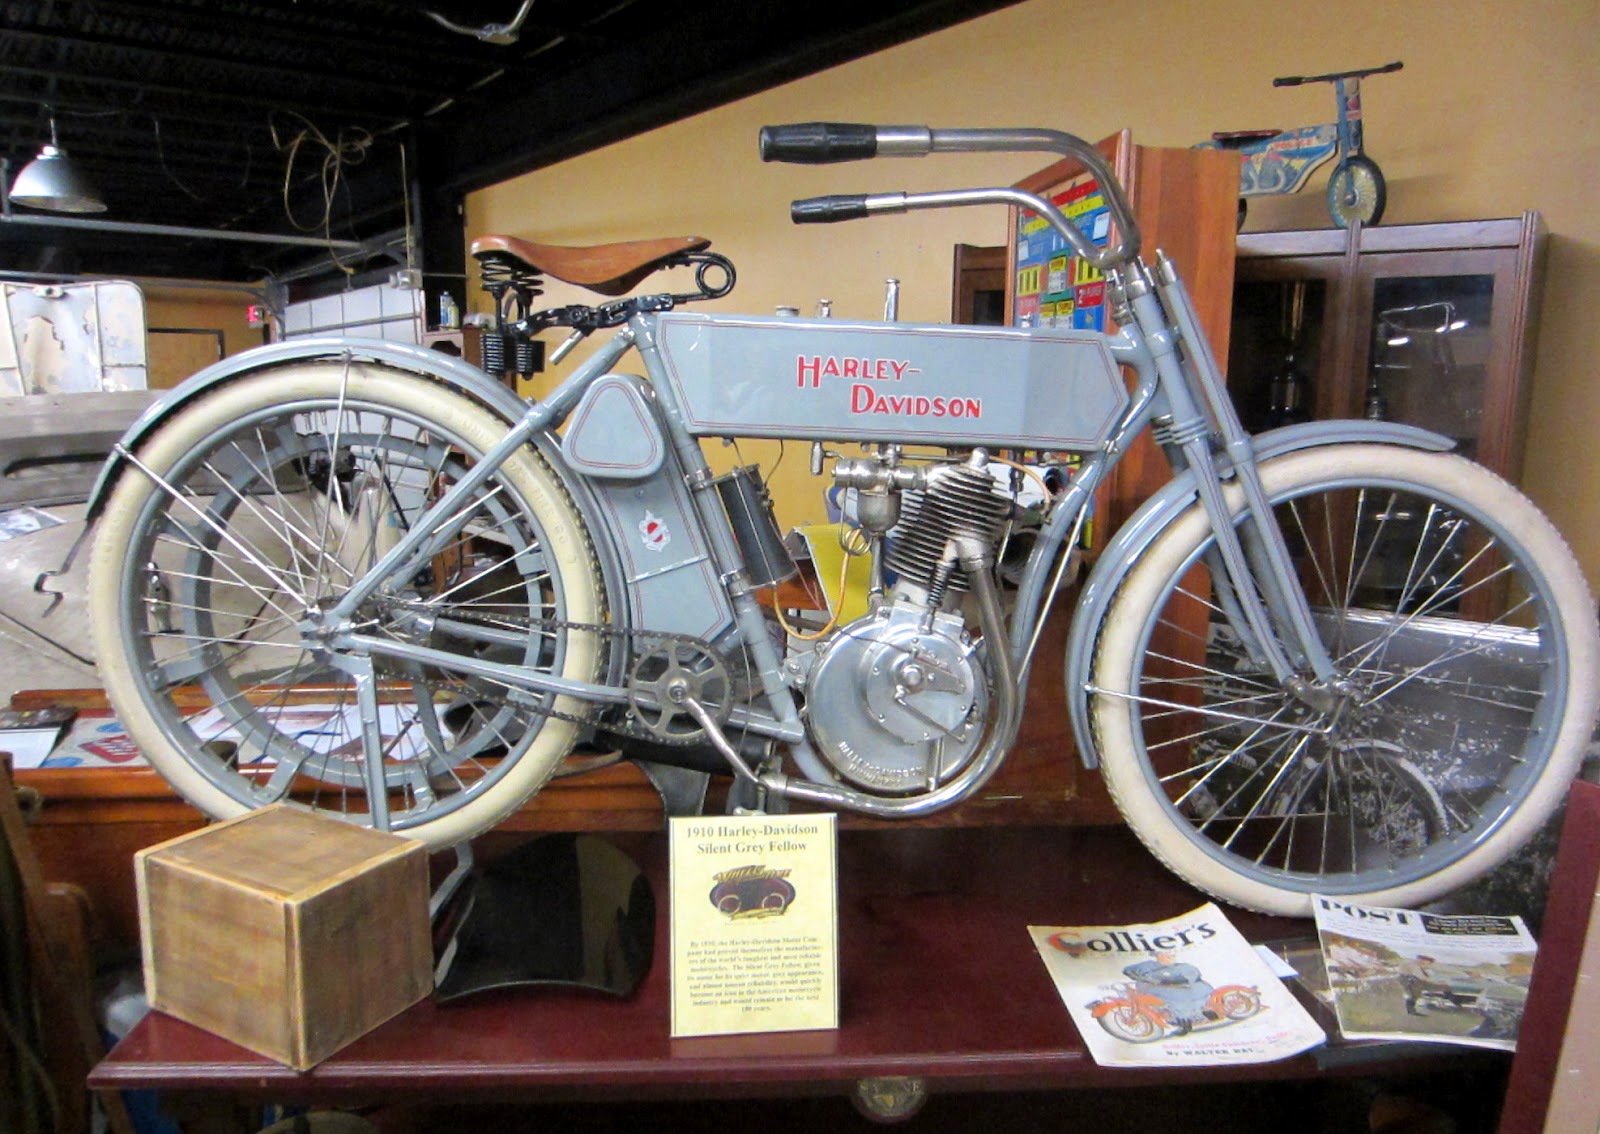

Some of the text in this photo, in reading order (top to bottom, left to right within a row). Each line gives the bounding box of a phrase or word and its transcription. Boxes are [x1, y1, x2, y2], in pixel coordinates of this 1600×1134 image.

[850, 382, 982, 419] DAVIDSON
[687, 824, 818, 839] 1910 Harley-Davidson
[697, 840, 808, 855] Silent Grey Fellow
[1047, 922, 1217, 958] Collier's
